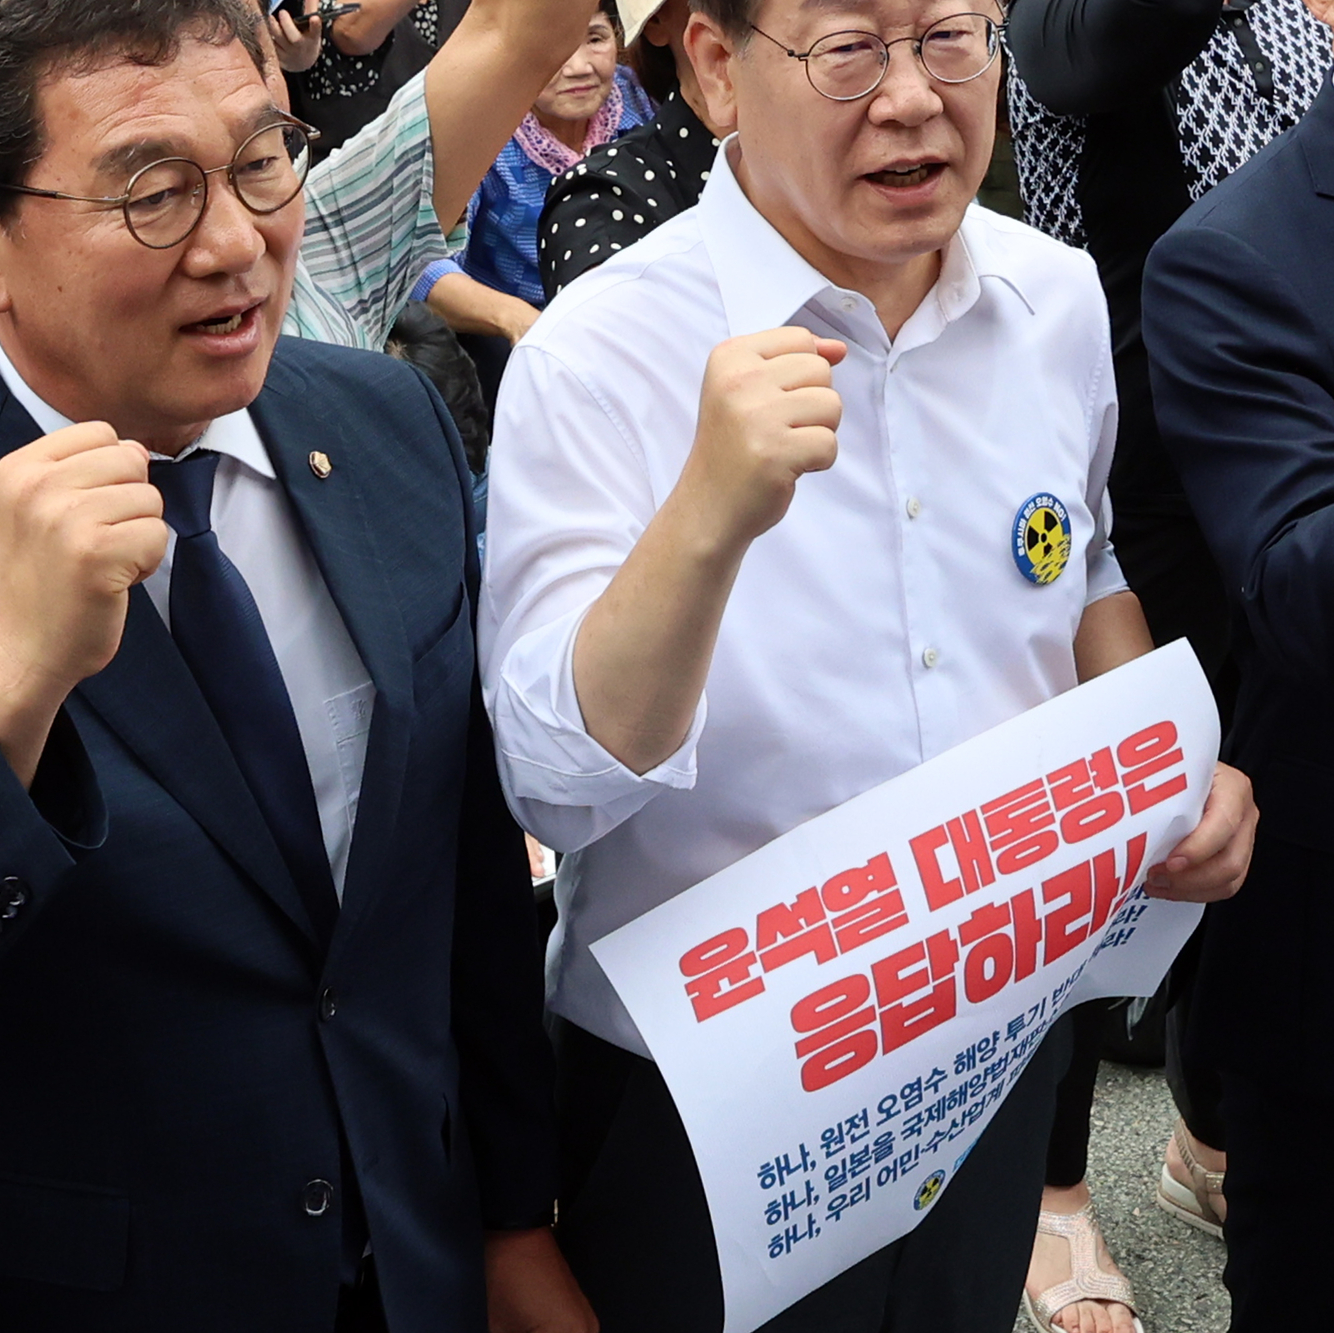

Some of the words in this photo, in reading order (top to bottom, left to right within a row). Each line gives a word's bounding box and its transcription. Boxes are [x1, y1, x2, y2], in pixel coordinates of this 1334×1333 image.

[1053, 502, 1067, 521] NO!
[677, 850, 910, 1024] 윤석열
[907, 719, 1190, 913] 대통령은
[788, 831, 1148, 1093] 응답하라!
[756, 1142, 818, 1192] 하나,
[819, 1107, 870, 1155] 원전
[874, 1066, 949, 1127] 오염수
[952, 1030, 1001, 1087] 해양
[1002, 992, 1048, 1046] 투기
[764, 1180, 821, 1228] 하나,
[823, 1134, 896, 1196] 일본을
[767, 1215, 823, 1261] 하나,
[824, 1184, 871, 1226] 우리
